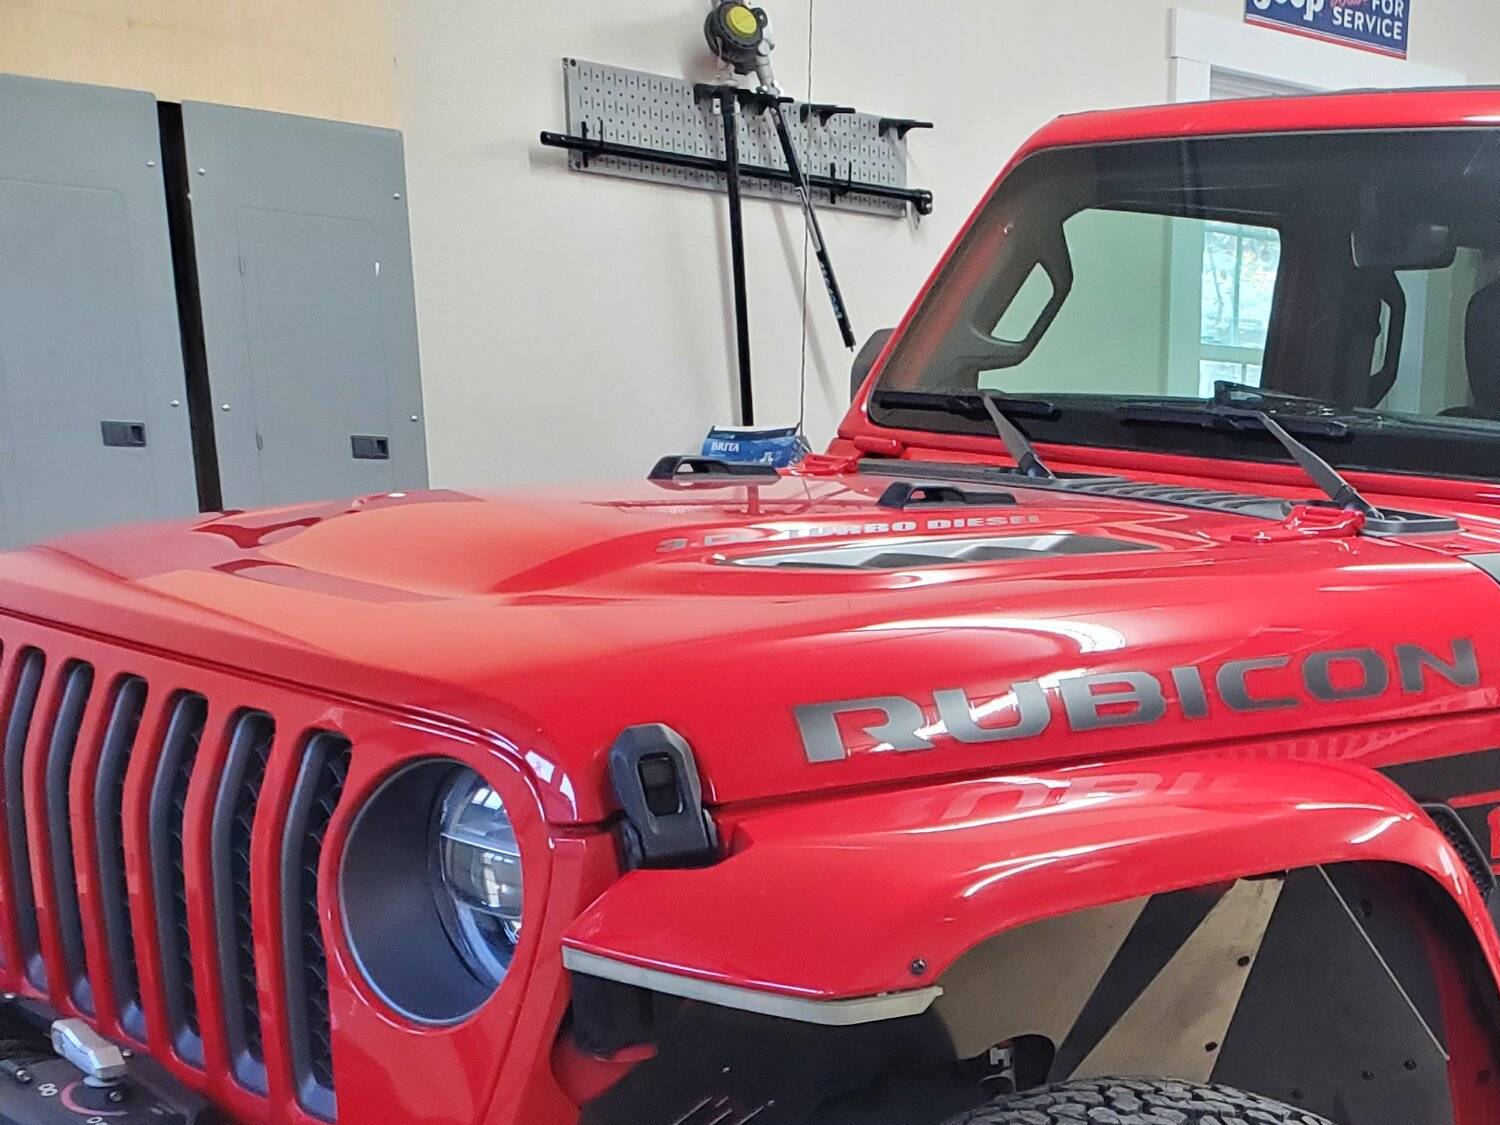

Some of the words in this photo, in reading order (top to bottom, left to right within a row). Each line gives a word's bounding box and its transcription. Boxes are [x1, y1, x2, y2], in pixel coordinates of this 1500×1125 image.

[1332, 6, 1403, 40] SERVICE
[710, 441, 740, 453] BRITA
[794, 638, 1481, 763] RUBICON
